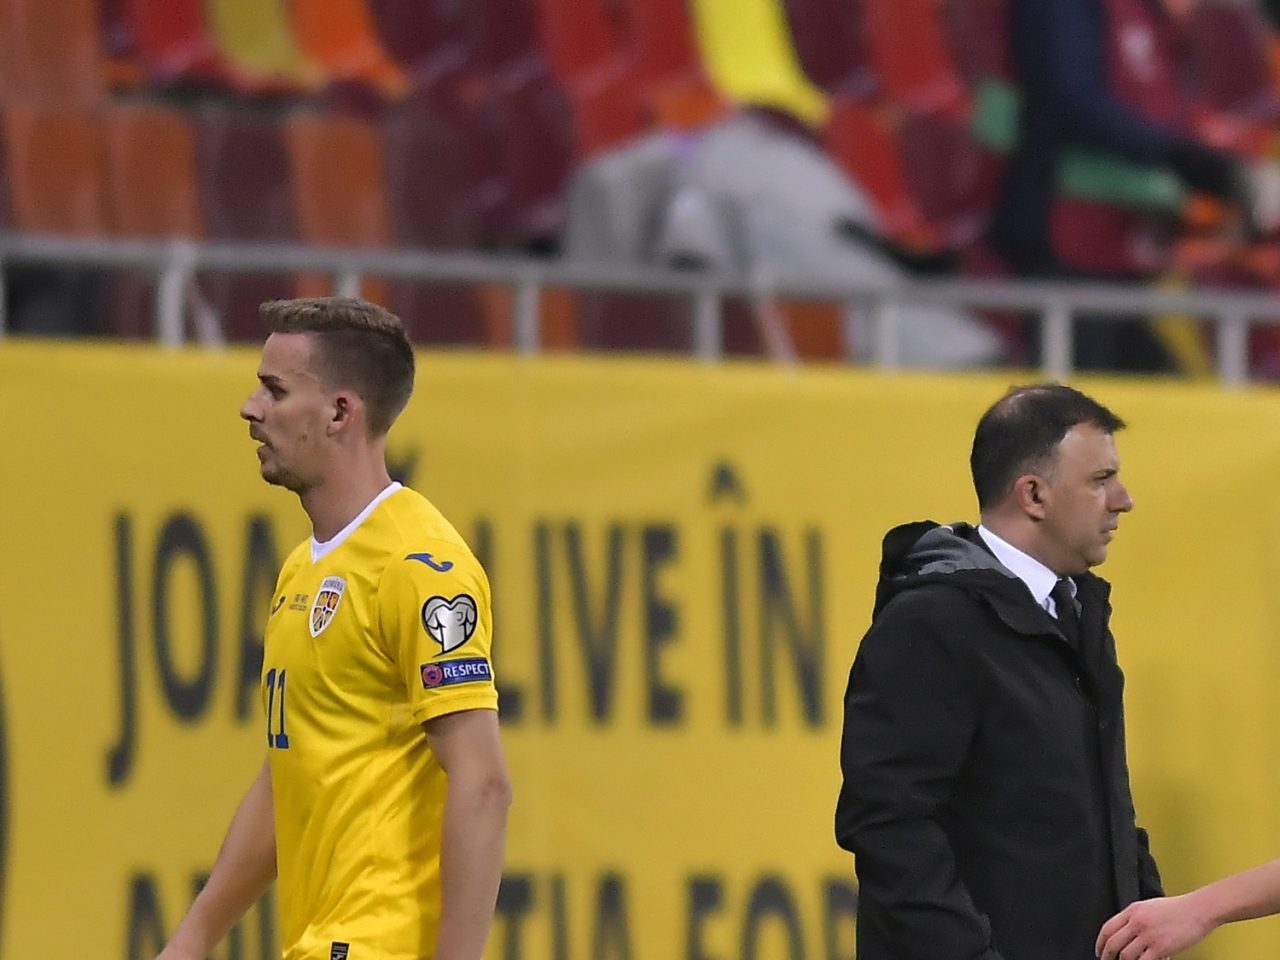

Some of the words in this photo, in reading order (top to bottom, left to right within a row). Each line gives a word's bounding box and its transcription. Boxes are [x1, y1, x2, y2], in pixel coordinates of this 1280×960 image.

[472, 516, 686, 728] LIVE
[707, 457, 826, 731] ÎN
[266, 668, 289, 749] 11
[443, 663, 490, 679] RESPECT
